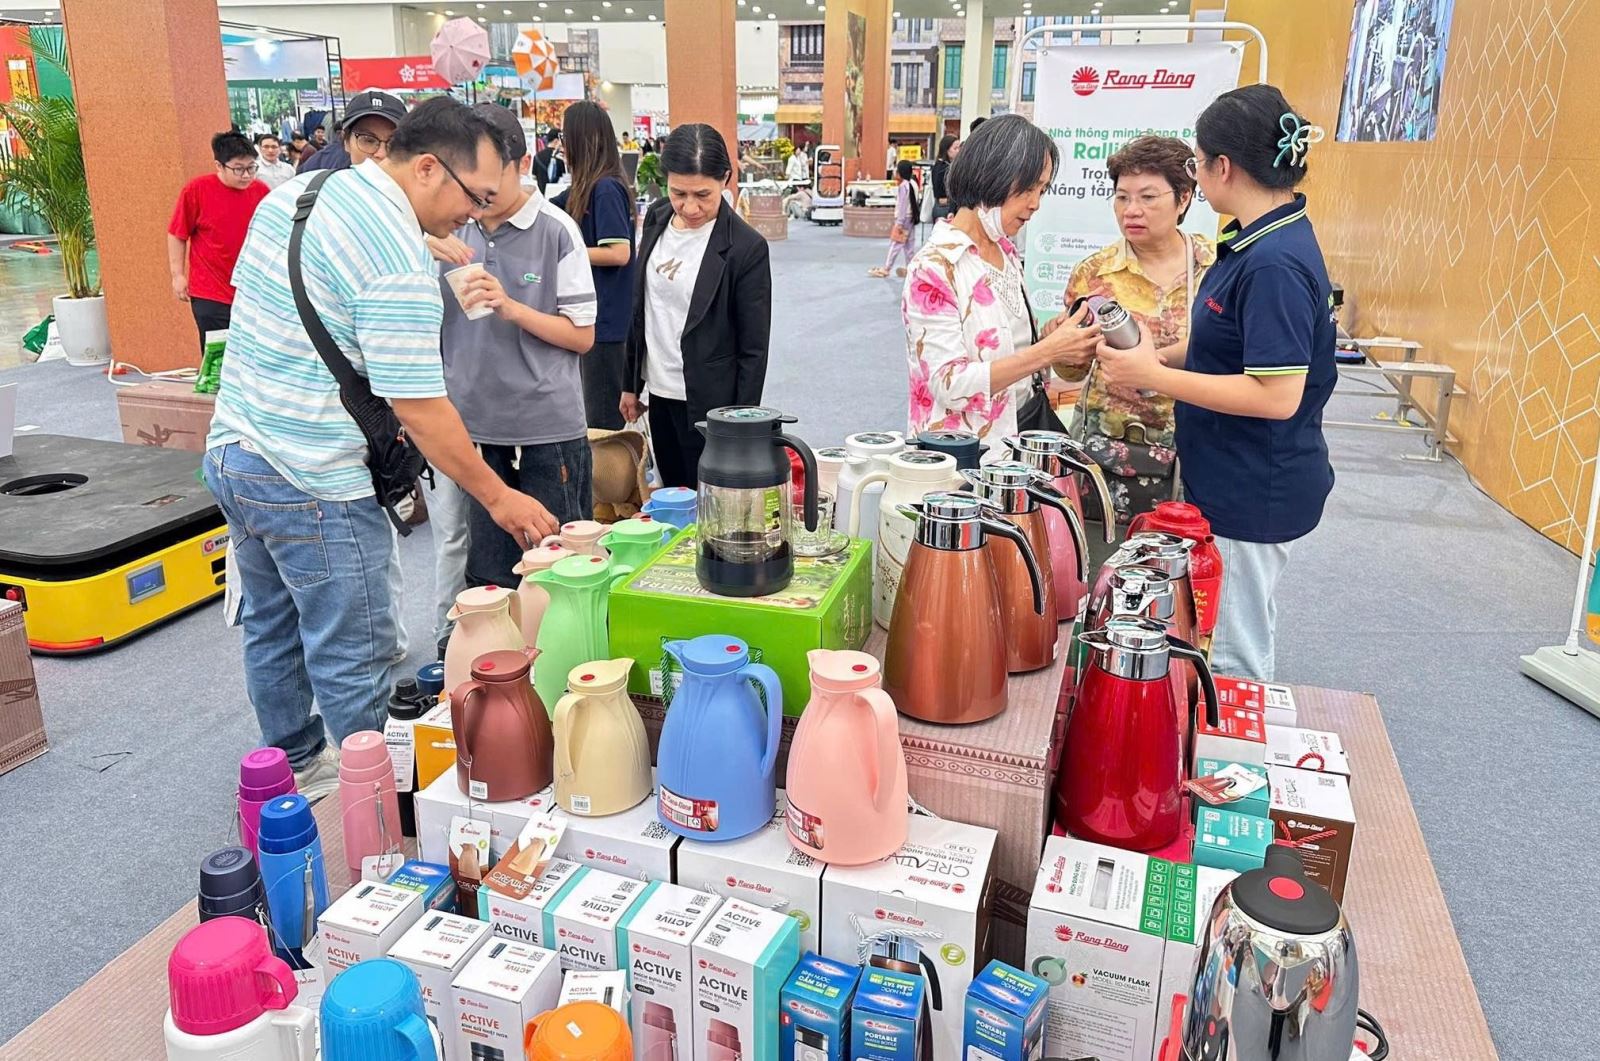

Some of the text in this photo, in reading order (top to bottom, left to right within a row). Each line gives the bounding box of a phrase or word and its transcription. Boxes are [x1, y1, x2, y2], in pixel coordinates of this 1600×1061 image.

[1048, 128, 1071, 138] Nhà
[1075, 128, 1108, 140] thông
[1113, 128, 1140, 138] minh
[1048, 184, 1085, 199] Nâng
[581, 900, 618, 913] ACTIVE
[655, 914, 694, 928] ACTIVE
[724, 911, 762, 928] ACTIVE
[494, 922, 539, 943] ACTIVE
[327, 946, 361, 961] ACTIVE
[560, 943, 606, 966] ACTIVE
[633, 959, 682, 982] ACTIVE
[1093, 968, 1150, 987] VACUUM FLASK
[699, 975, 748, 1001] ACTIVE
[461, 1012, 500, 1030] ACTIVE
[865, 1031, 897, 1041] PORTABLE
